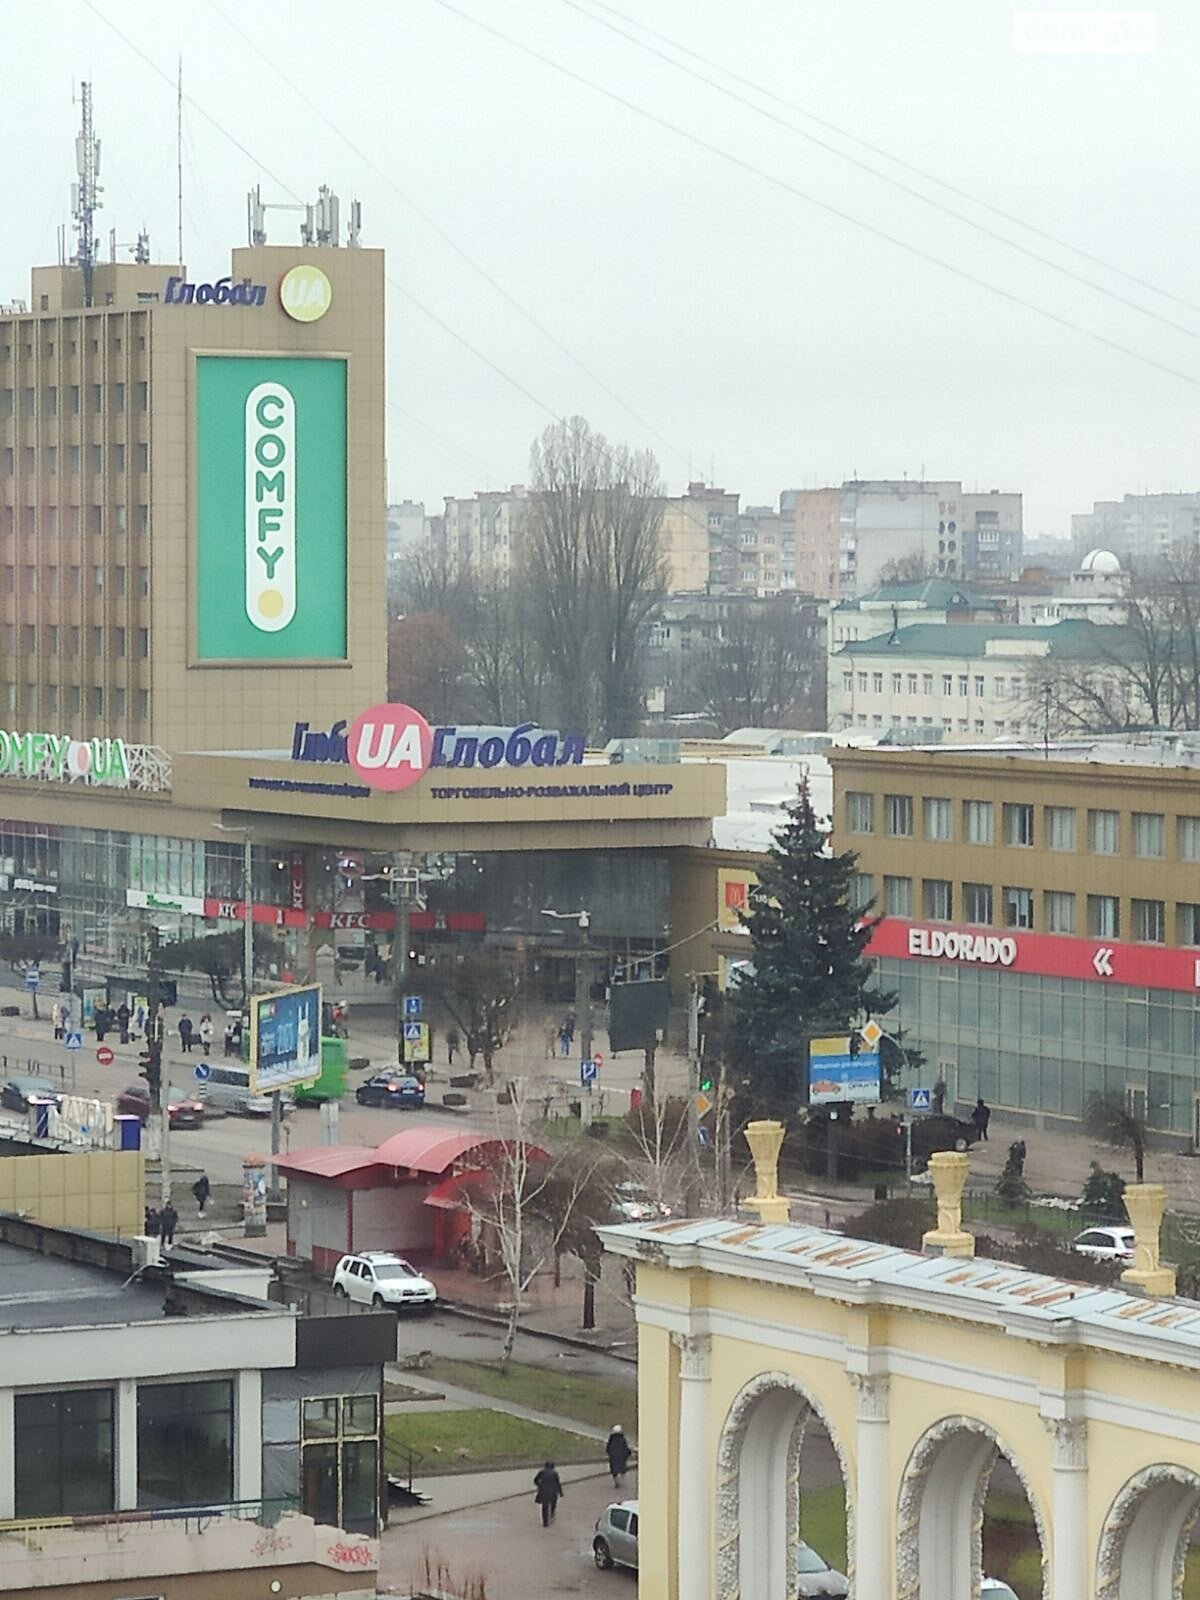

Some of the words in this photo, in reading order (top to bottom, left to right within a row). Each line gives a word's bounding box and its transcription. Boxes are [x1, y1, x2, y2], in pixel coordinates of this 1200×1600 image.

[164, 276, 267, 307] Глобал
[286, 277, 326, 308] UA
[255, 394, 286, 580] COMFY
[356, 723, 422, 769] UA
[432, 721, 587, 767] Глобал
[633, 783, 673, 798] ЦЕНТР
[218, 902, 237, 919] KFC
[329, 913, 371, 928] KFC
[908, 927, 1018, 966] ELDORADO
